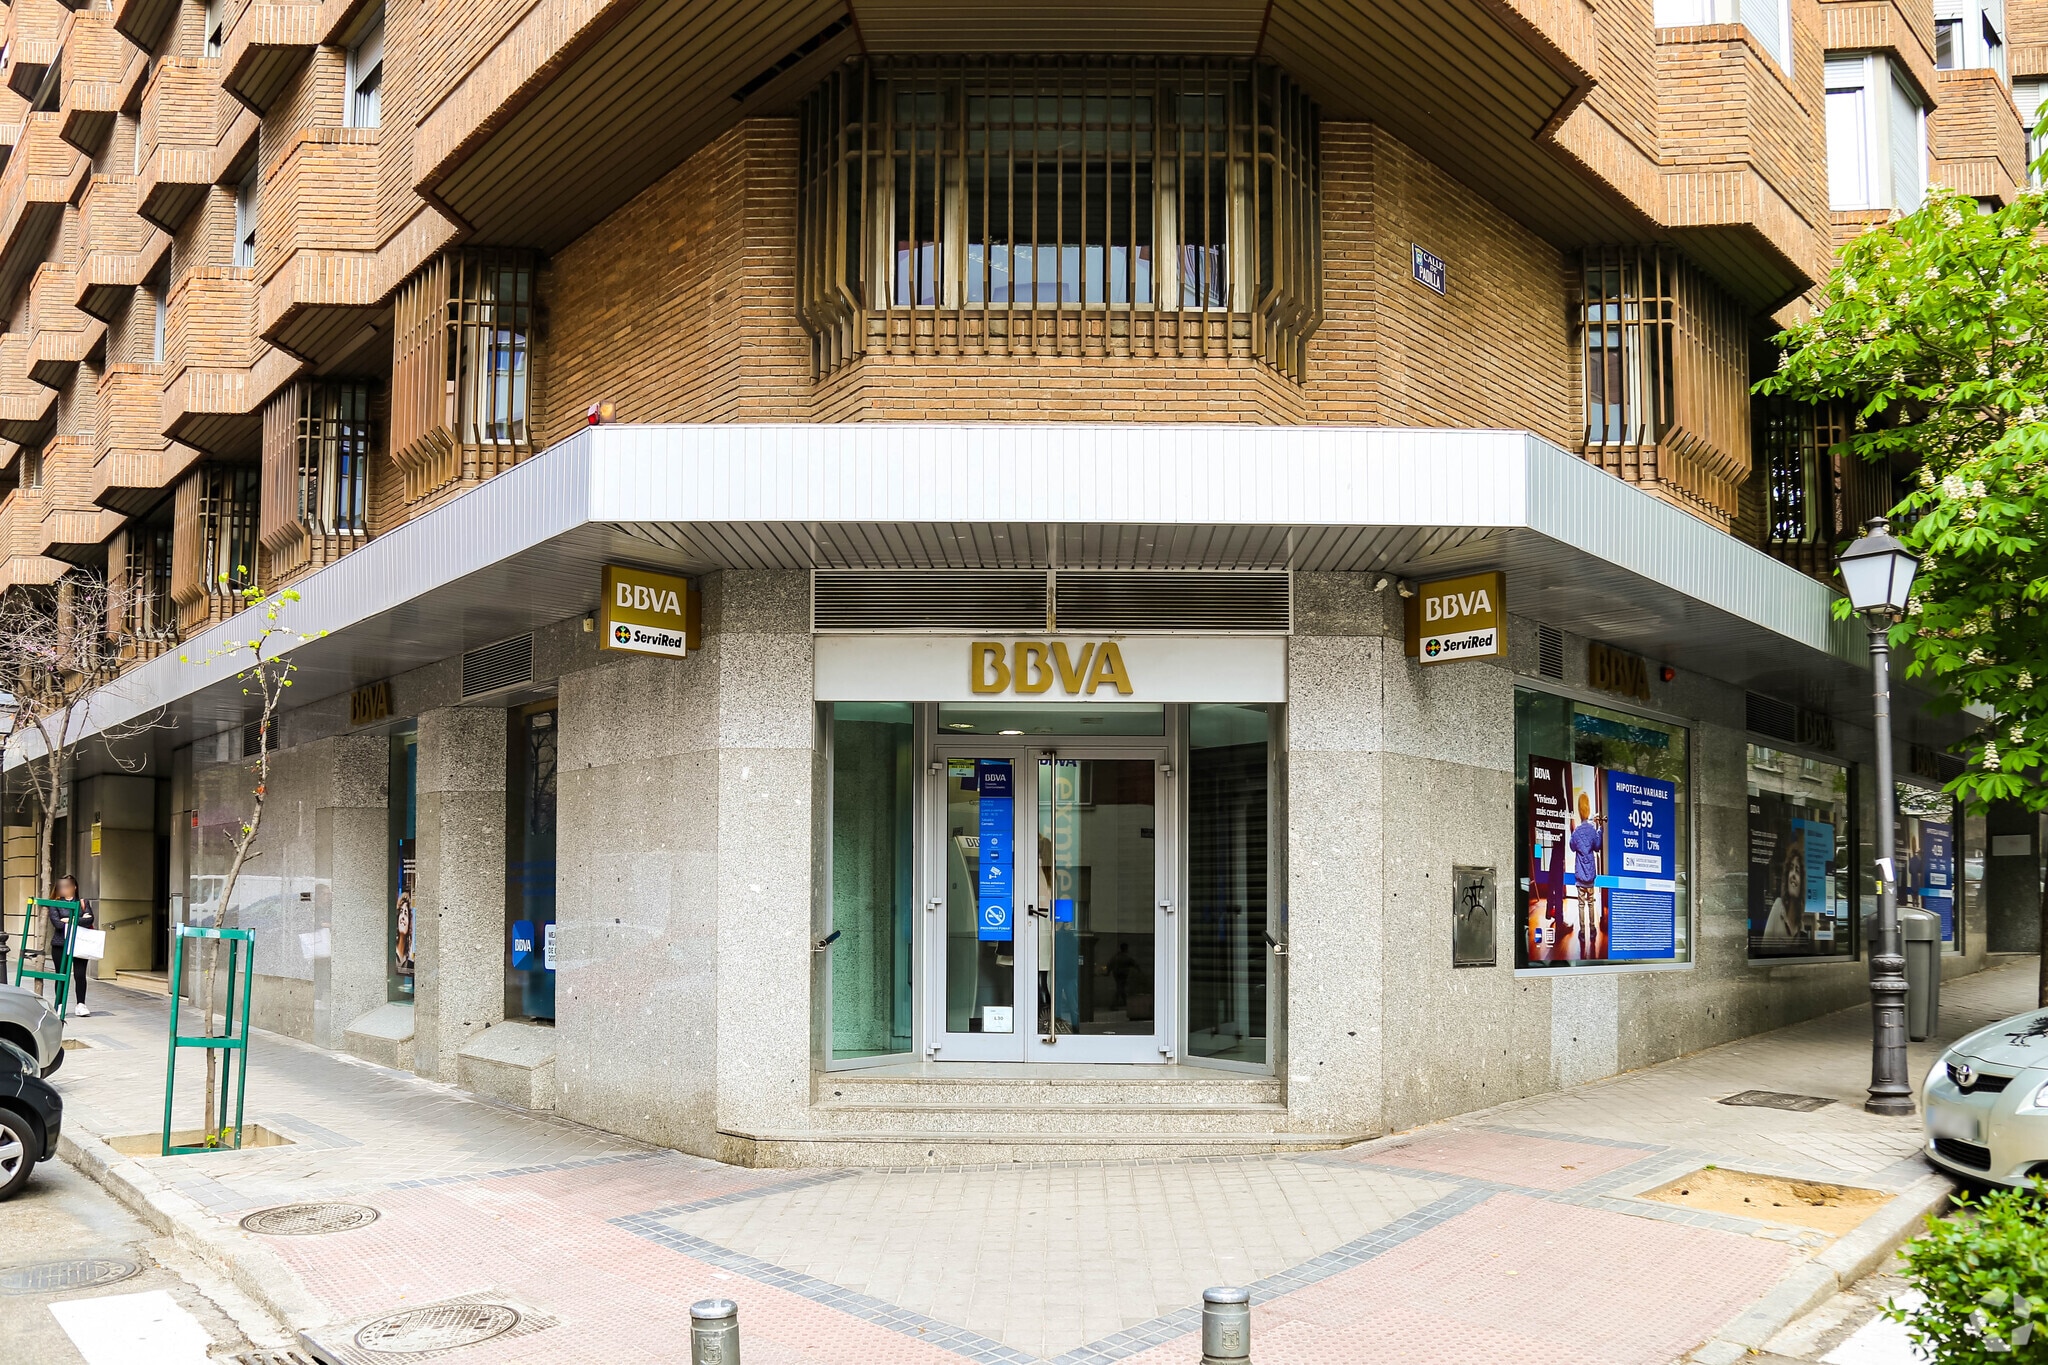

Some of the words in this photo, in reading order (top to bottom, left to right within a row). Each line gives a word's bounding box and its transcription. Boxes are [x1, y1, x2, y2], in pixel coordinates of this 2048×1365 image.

[1423, 252, 1444, 271] CALLE
[1429, 264, 1438, 274] DE
[1419, 265, 1441, 290] PADILLA
[616, 582, 681, 616] BBVA
[1425, 589, 1492, 622] BBVA
[633, 630, 683, 649] ServiRed
[1443, 633, 1493, 652] ServiRed
[971, 641, 1134, 694] BBVA
[1590, 643, 1650, 700] BBVA
[351, 681, 391, 726] BBVA
[984, 773, 1007, 782] BBVA
[1534, 767, 1551, 781] BBVA
[1616, 782, 1643, 795] HIPOTECA
[1643, 787, 1669, 800] VARIABLE
[1628, 809, 1653, 829] +0,99
[1624, 838, 1639, 848] 1,99%
[1044, 776, 1073, 931] expre
[514, 939, 531, 952] BBVA
